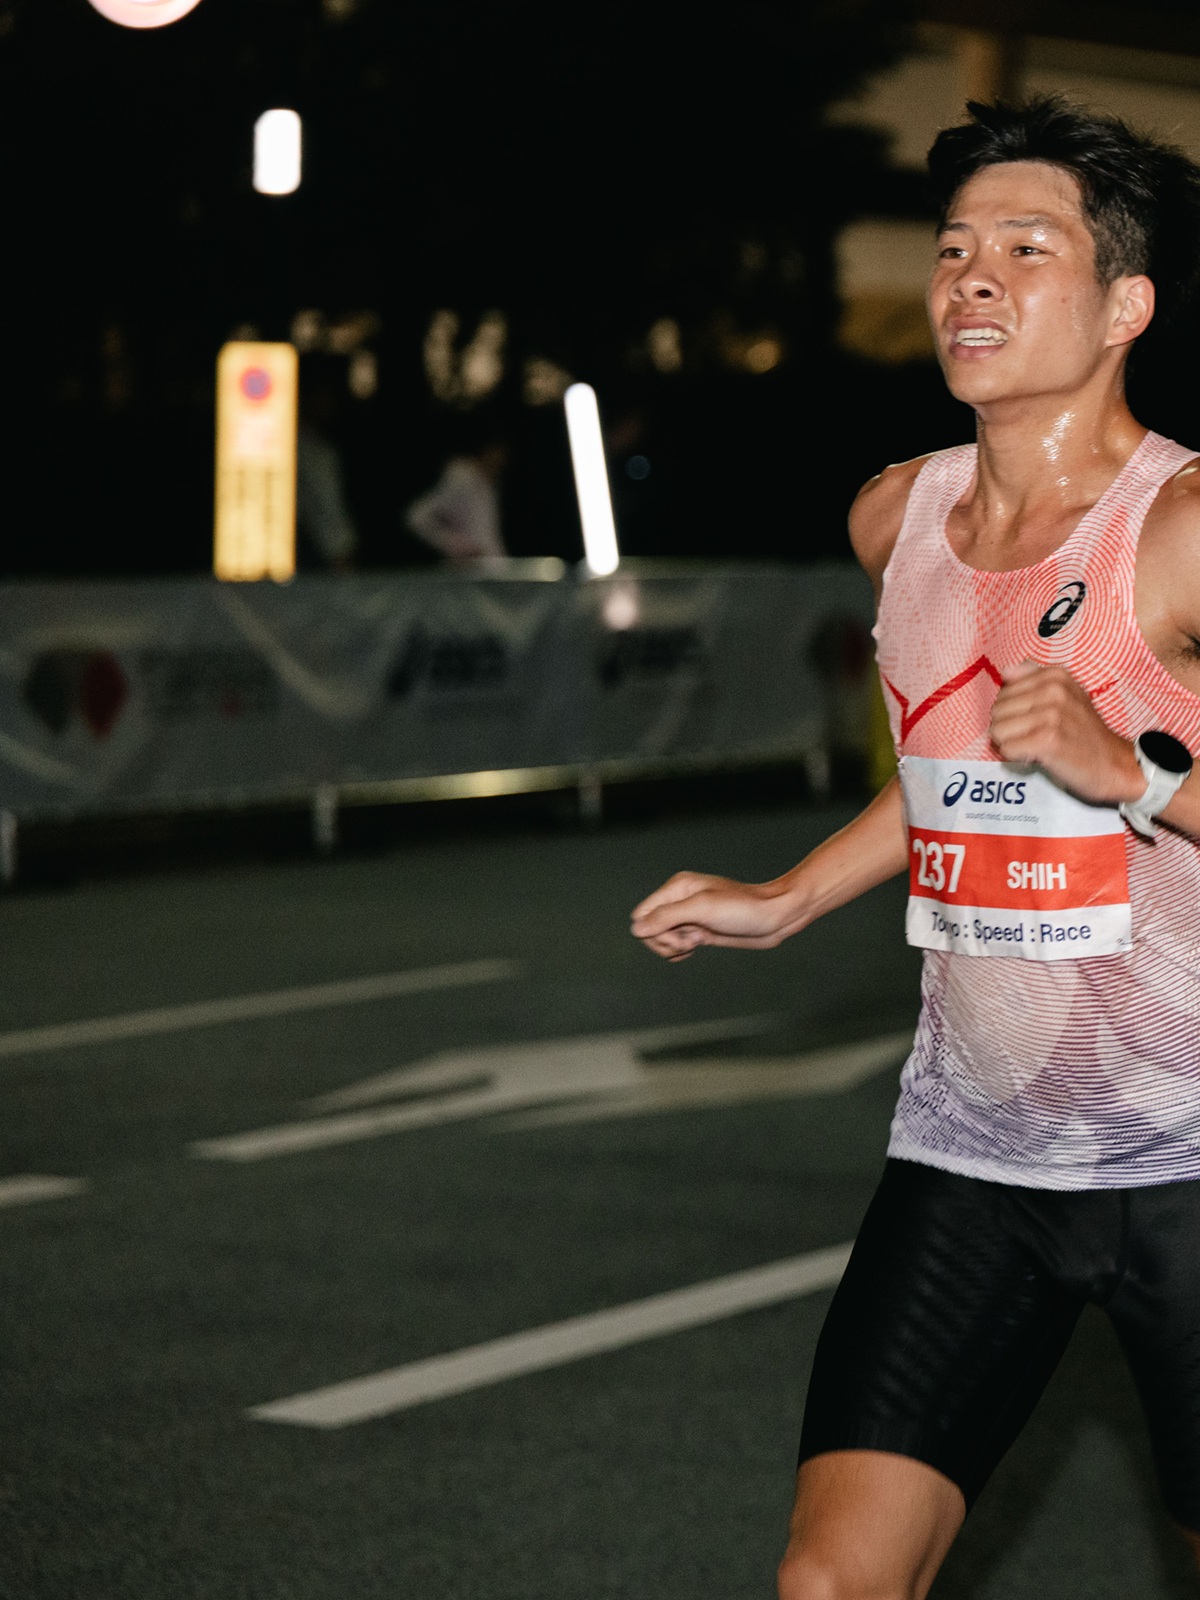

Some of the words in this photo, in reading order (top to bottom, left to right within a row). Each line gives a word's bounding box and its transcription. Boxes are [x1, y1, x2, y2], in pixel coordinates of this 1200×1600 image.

[970, 780, 1026, 805] asics
[912, 838, 966, 893] 237
[1007, 861, 1067, 890] SHIH
[973, 918, 1024, 944] Speed
[1040, 923, 1092, 943] Race
